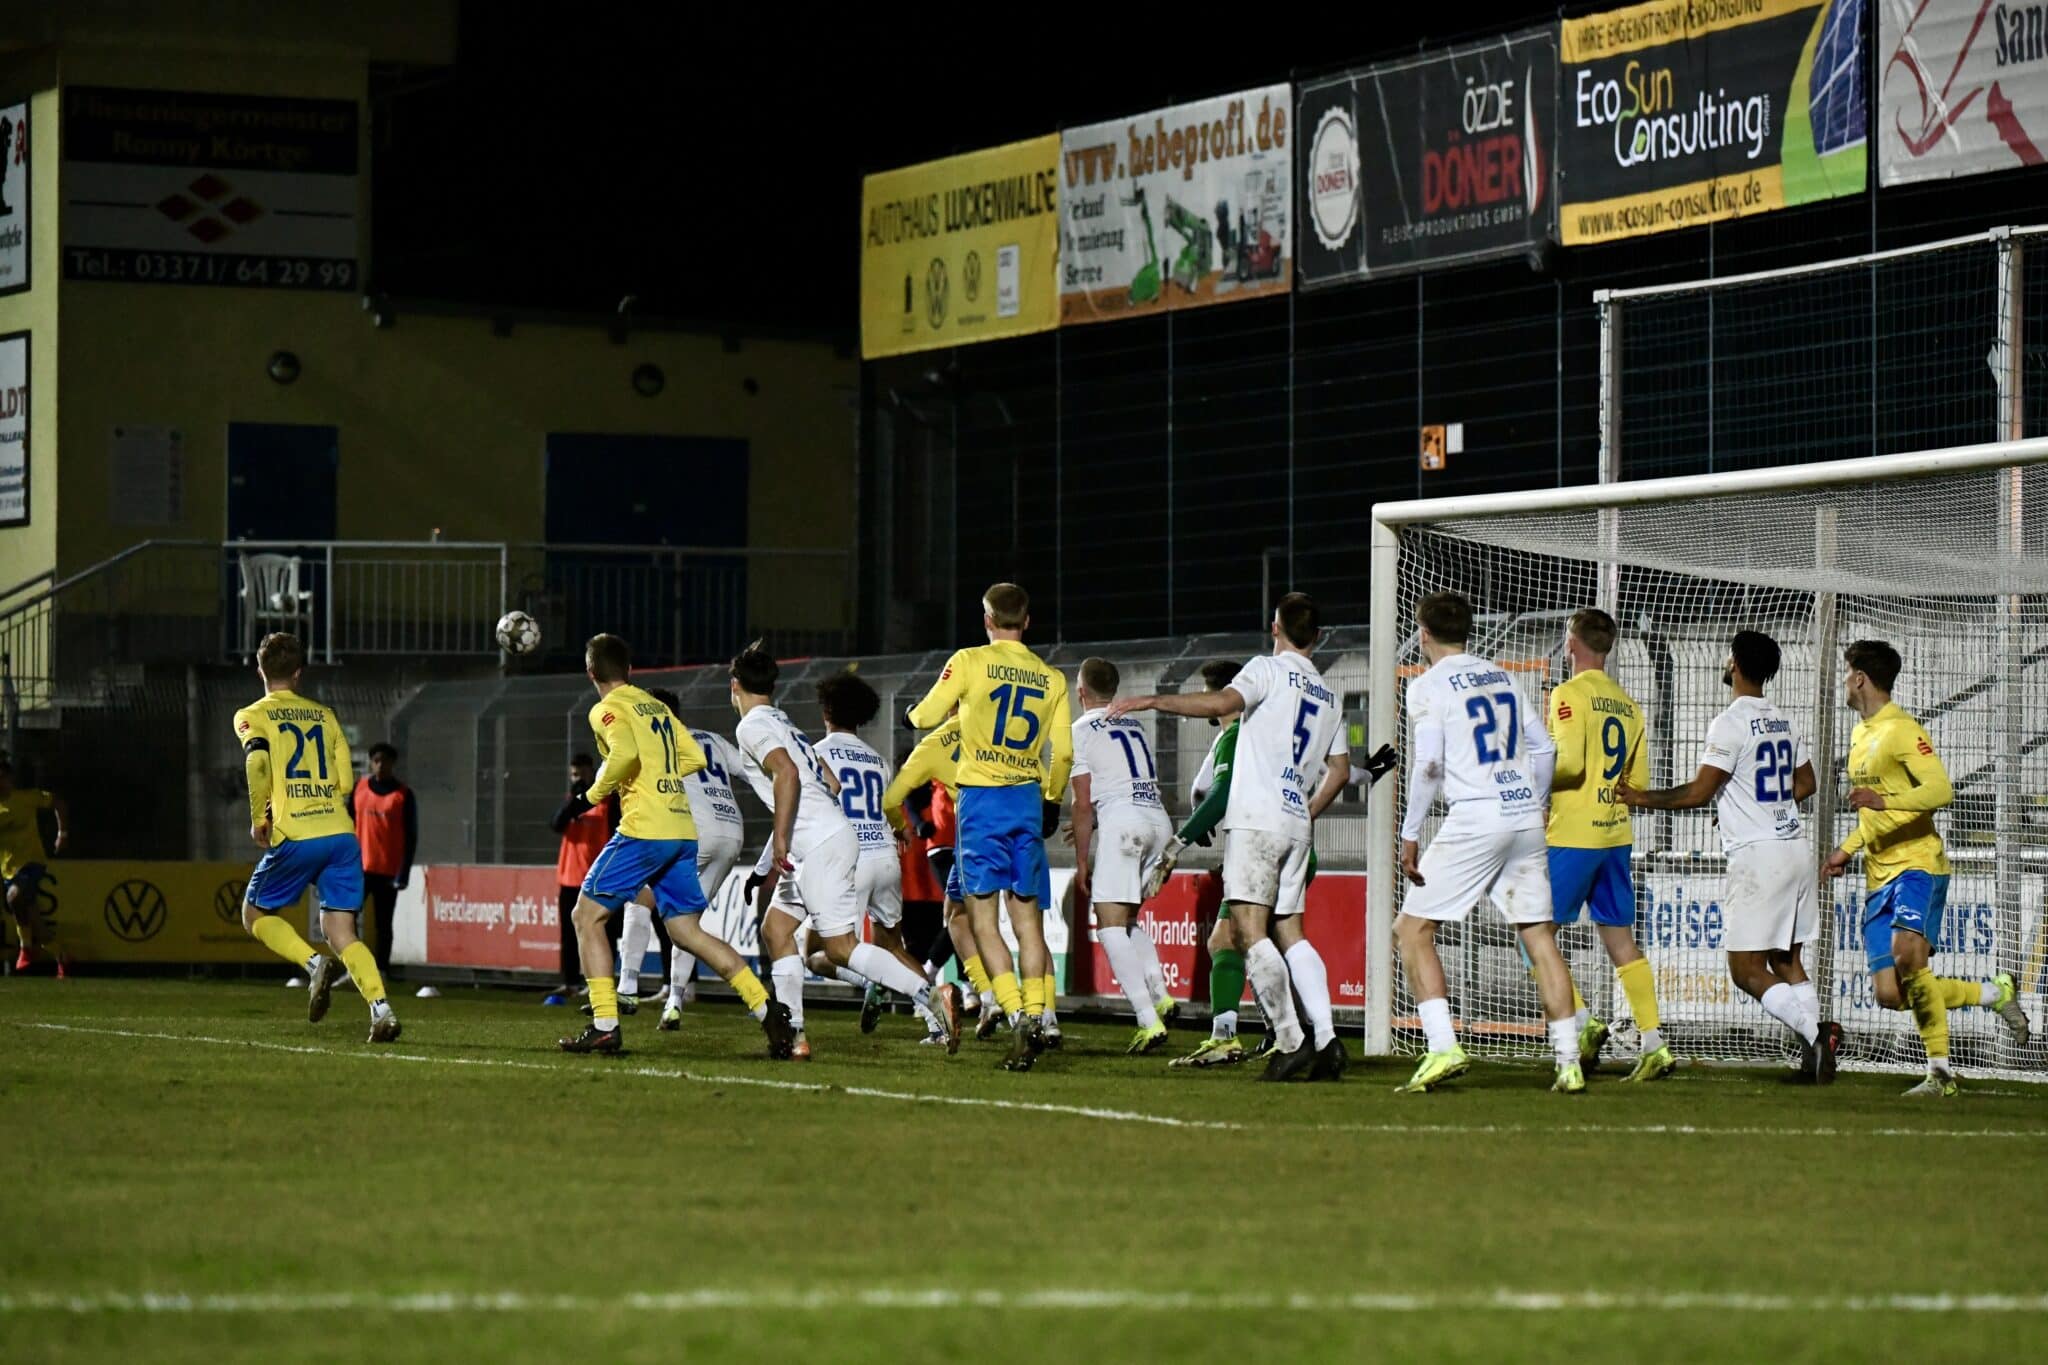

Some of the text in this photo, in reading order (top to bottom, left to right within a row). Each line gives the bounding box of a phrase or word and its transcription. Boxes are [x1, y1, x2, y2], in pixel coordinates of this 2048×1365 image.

[1579, 25, 1604, 53] IHRE
[1995, 4, 2048, 67] San
[1064, 95, 1287, 188] www.hebeprofi.de
[1615, 88, 1764, 168] Consulting
[1423, 129, 1523, 215] DÖNER
[866, 168, 1057, 248] AUTOHAUS LUCKENWALDE
[1577, 179, 1763, 238] www.ecosun-consulting.de
[235, 261, 268, 283] 64
[278, 262, 308, 285] 29
[320, 262, 352, 287] 99
[987, 664, 1050, 690] LUCKENWALDE
[1289, 671, 1301, 689] FC
[1449, 669, 1512, 692] FC Eilenburg
[266, 708, 326, 723] LUCKENWALDE
[990, 683, 1045, 750] 15
[1090, 718, 1107, 732] FC
[1293, 697, 1320, 767] 5
[1466, 691, 1518, 767] 27
[1751, 718, 1765, 736] FC
[278, 722, 328, 780] 21
[651, 716, 679, 775] 11
[829, 748, 844, 761] FC
[845, 749, 885, 769] Eilenburg
[1602, 715, 1627, 781] 9
[286, 783, 338, 799] VIERLING
[1755, 738, 1794, 803] 22
[712, 803, 736, 815] ERGO
[839, 767, 884, 822] 20
[1499, 786, 1533, 802] ERGO
[856, 831, 885, 842] ERGO
[1339, 979, 1366, 999] mbs.de
